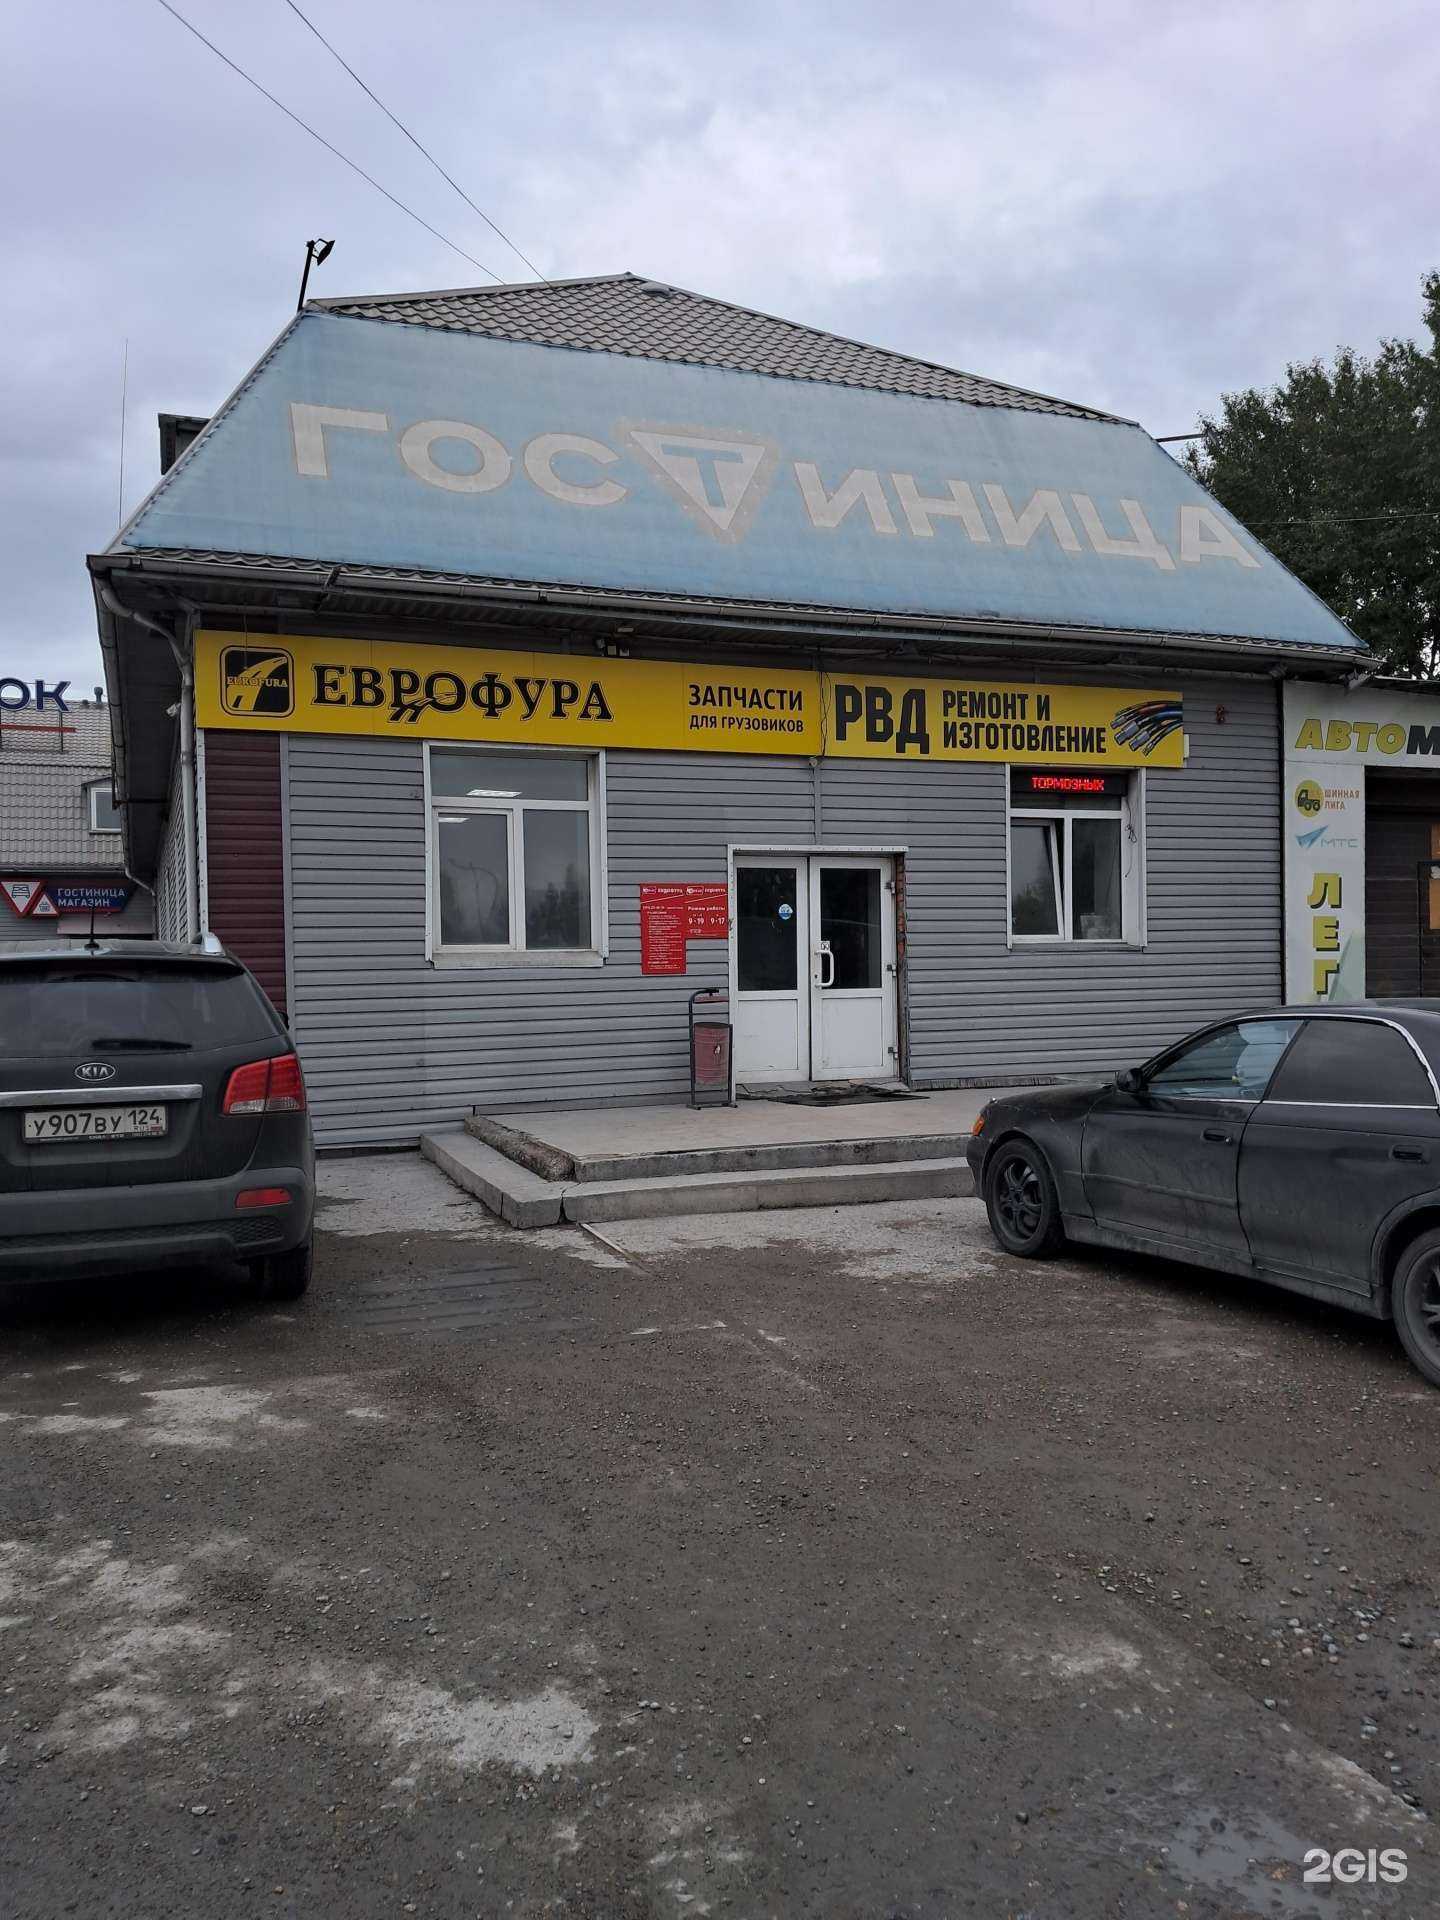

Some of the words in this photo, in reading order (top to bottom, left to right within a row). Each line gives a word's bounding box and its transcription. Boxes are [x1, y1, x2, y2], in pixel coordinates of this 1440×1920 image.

[289, 402, 1263, 571] ГОСТИНИЦА
[311, 663, 615, 723] ЕВРОФУРА
[688, 684, 803, 712] ЗАПЧАСТИ
[942, 689, 1029, 721] РЕМОНТ
[1036, 694, 1051, 722] И
[689, 714, 717, 731] ДЛЯ
[720, 715, 804, 733] ГРУЗОВИКОВ
[834, 684, 930, 755] РВД
[943, 721, 1107, 754] ИЗГОТОВЛЕНИЕ
[1324, 788, 1360, 799] ШИННАЯ
[1324, 800, 1345, 810] ЛИГА
[57, 887, 125, 898] ГОСТИНИЦА
[57, 898, 110, 907] МАГАЗИН
[81, 1065, 109, 1078] KIA
